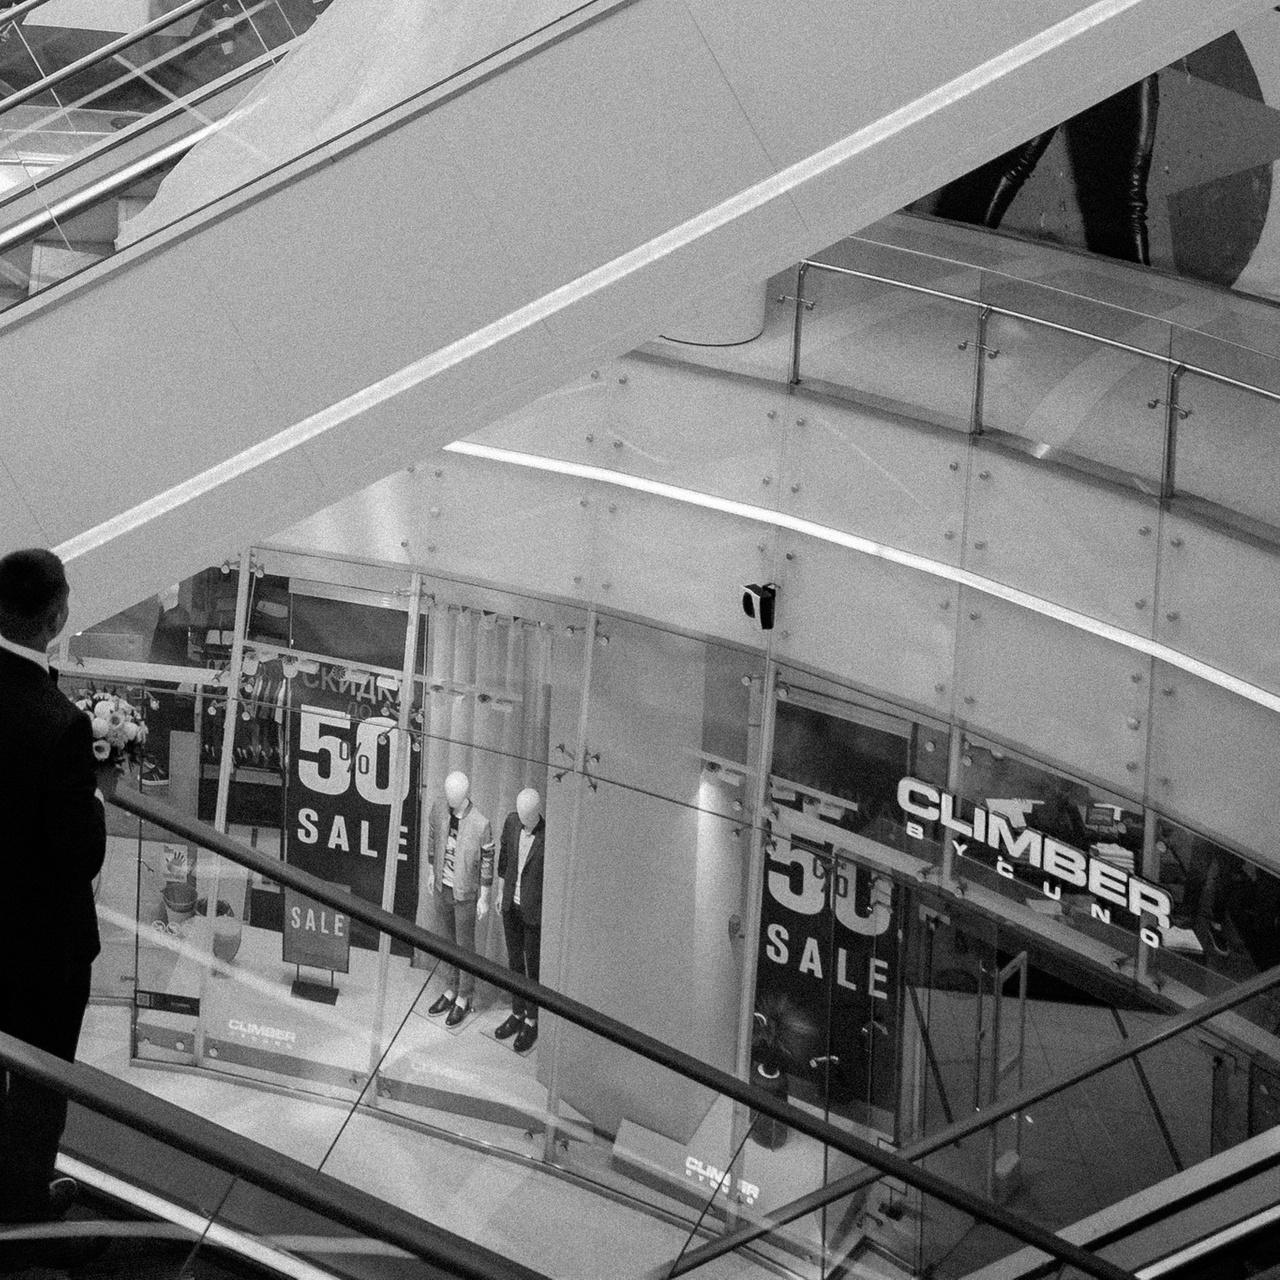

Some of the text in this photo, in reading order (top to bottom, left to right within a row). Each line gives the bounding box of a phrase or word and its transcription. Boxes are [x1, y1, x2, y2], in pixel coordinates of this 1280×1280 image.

[297, 807, 409, 861] SALE
[897, 776, 1171, 929] CLIMBER
[291, 906, 345, 937] SALE
[766, 923, 889, 1001] SALE
